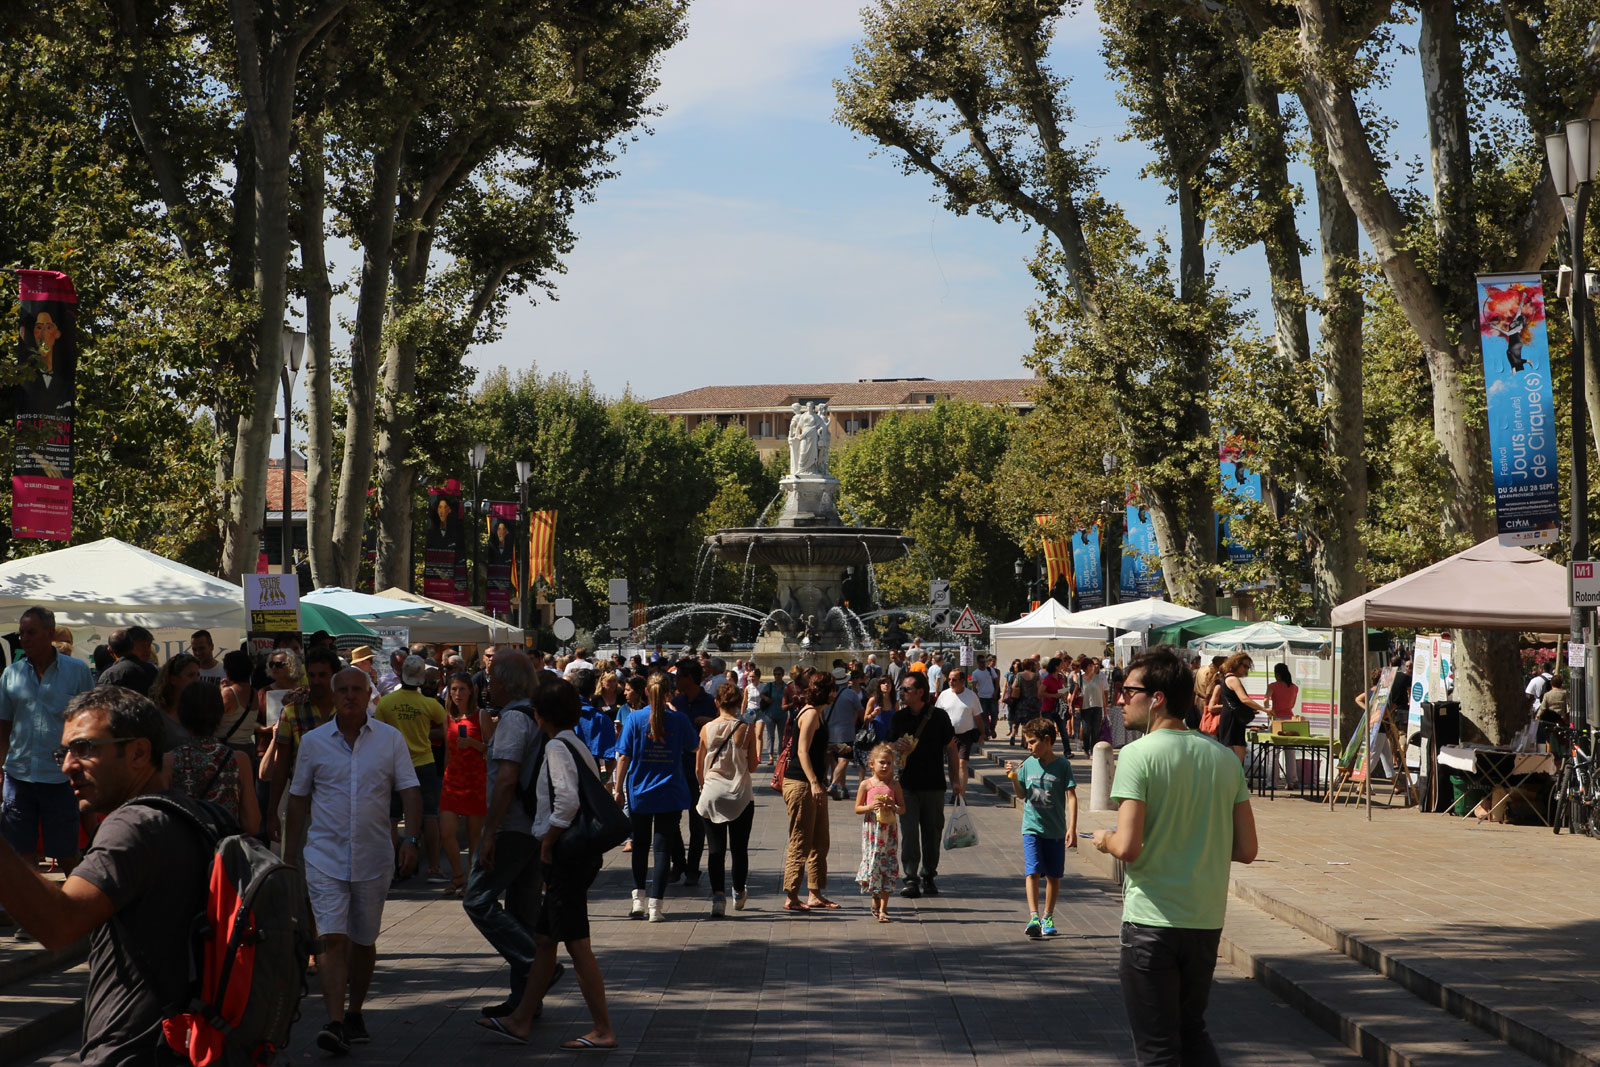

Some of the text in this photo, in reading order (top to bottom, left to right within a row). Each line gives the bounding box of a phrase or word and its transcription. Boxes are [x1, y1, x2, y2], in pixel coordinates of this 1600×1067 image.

[1523, 372, 1546, 450] Cirque(s)
[1498, 447, 1509, 476] Festival
[1511, 434, 1528, 479] Jours
[1530, 454, 1547, 478] de
[1576, 566, 1591, 576] M1
[252, 613, 264, 624] 14
